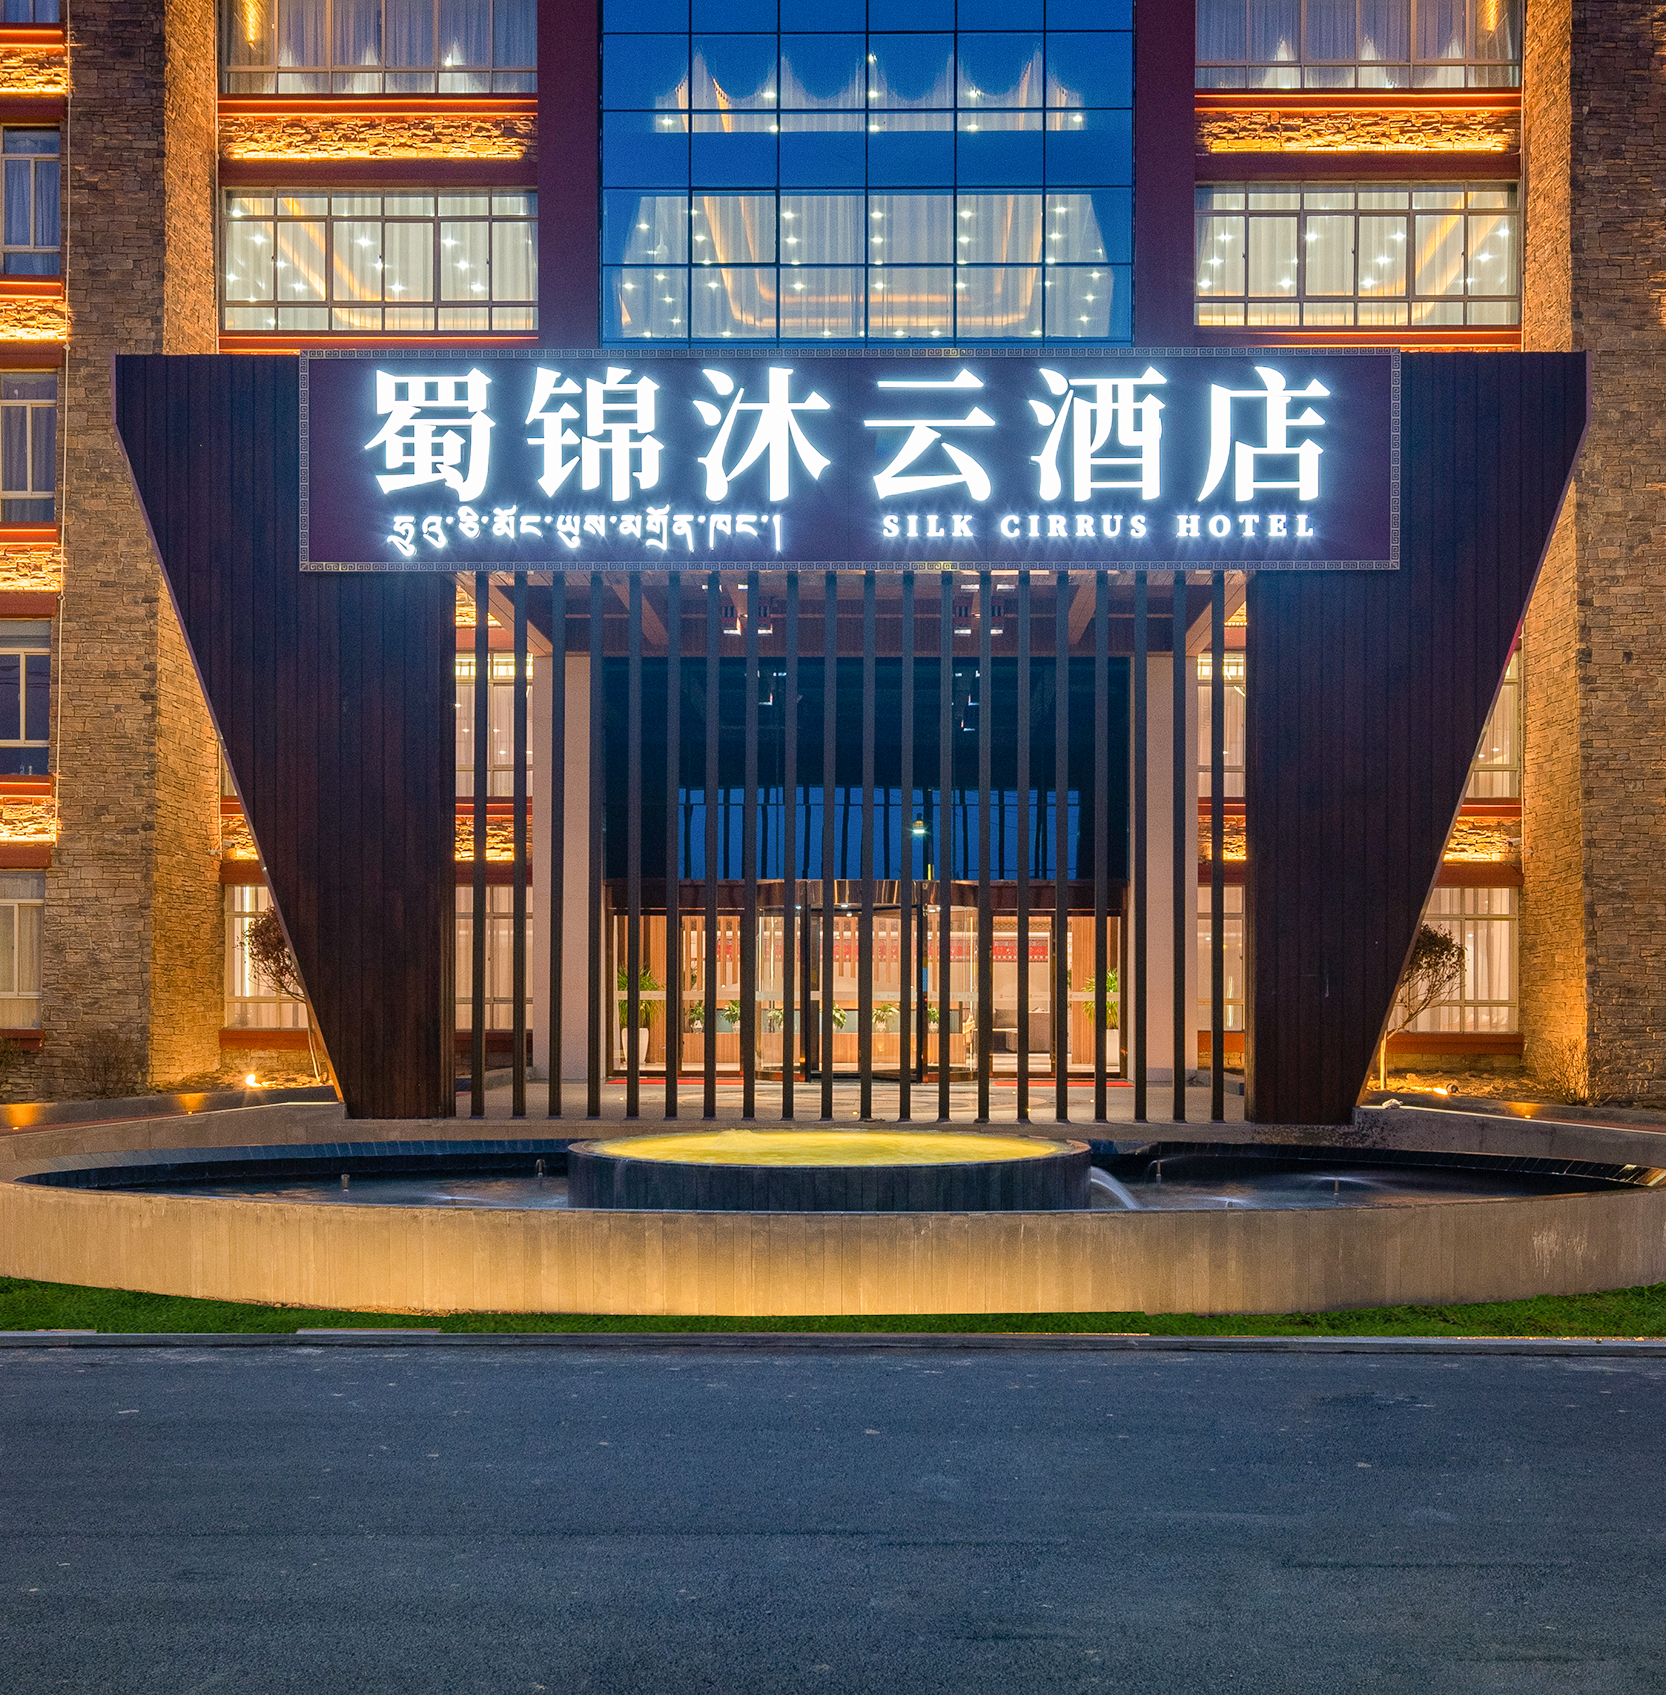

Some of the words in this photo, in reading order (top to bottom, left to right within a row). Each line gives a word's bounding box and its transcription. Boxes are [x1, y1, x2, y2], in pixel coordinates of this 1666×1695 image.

[364, 366, 1331, 503] 蜀锦沐云酒店
[882, 514, 974, 538] SILK
[1000, 514, 1147, 538] CIRRUS
[1176, 514, 1314, 538] HOTEL
